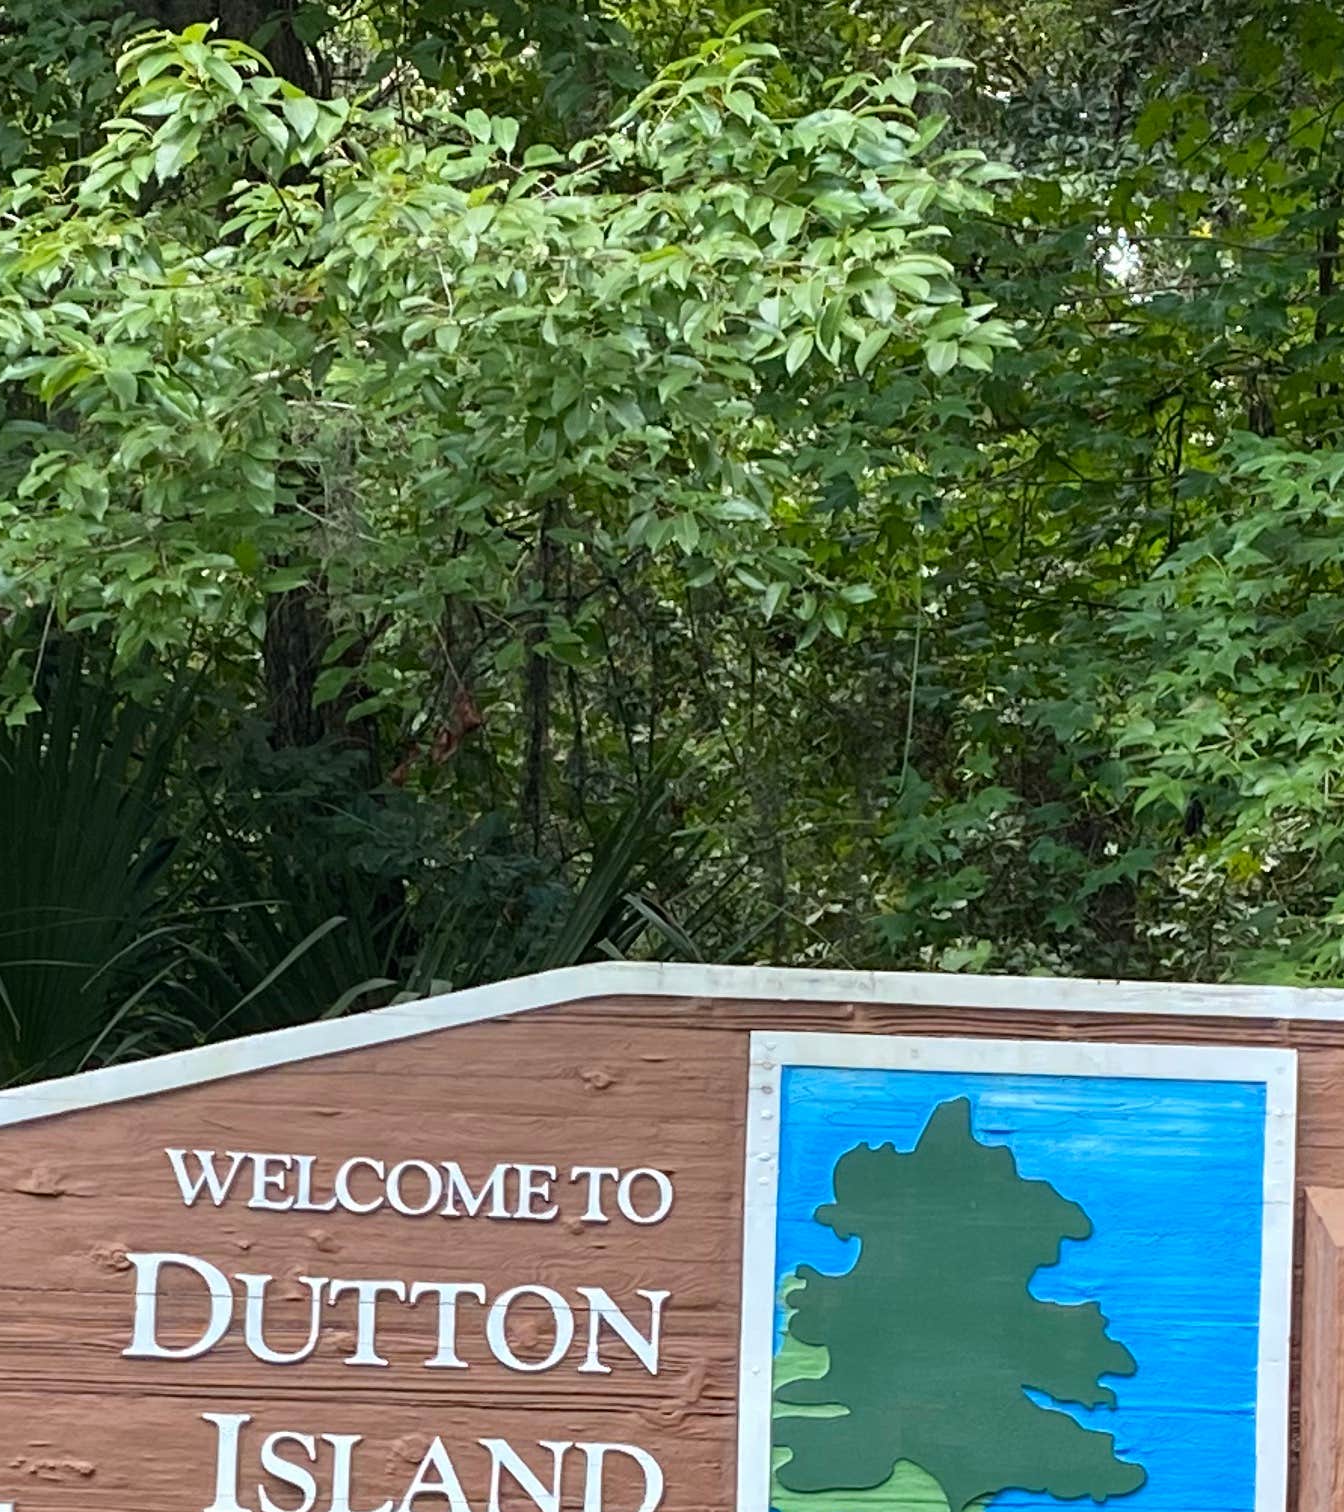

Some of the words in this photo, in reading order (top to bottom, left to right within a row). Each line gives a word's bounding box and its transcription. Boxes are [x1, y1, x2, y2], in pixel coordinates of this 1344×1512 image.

[164, 1147, 559, 1220] WELCOME
[563, 1165, 674, 1225] TO
[121, 1252, 672, 1376] DUTTON
